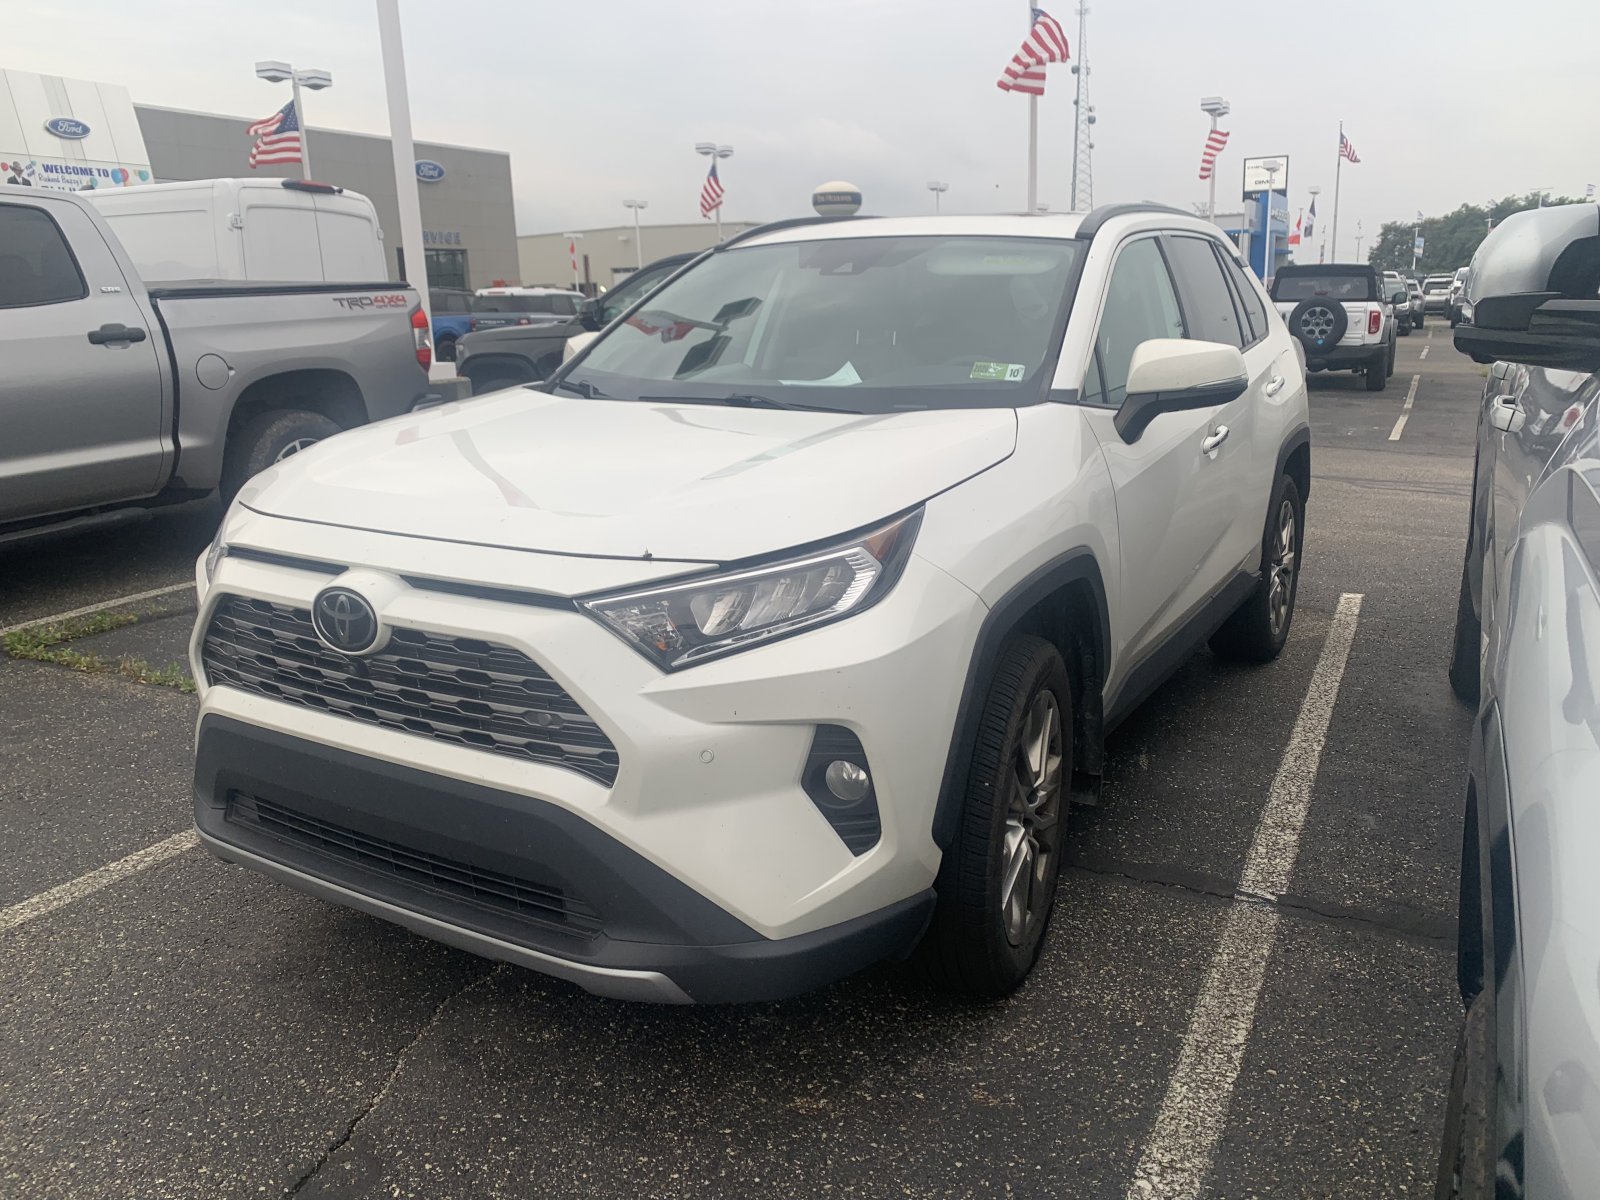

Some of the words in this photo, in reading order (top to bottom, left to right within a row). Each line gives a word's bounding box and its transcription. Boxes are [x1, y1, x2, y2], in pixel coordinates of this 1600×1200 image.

[57, 120, 83, 134] Ford
[42, 163, 95, 177] WELCOME
[97, 167, 110, 178] TO
[418, 163, 440, 177] Ford
[422, 230, 463, 245] RVICE
[332, 296, 374, 310] TRD
[1008, 368, 1020, 378] 10
